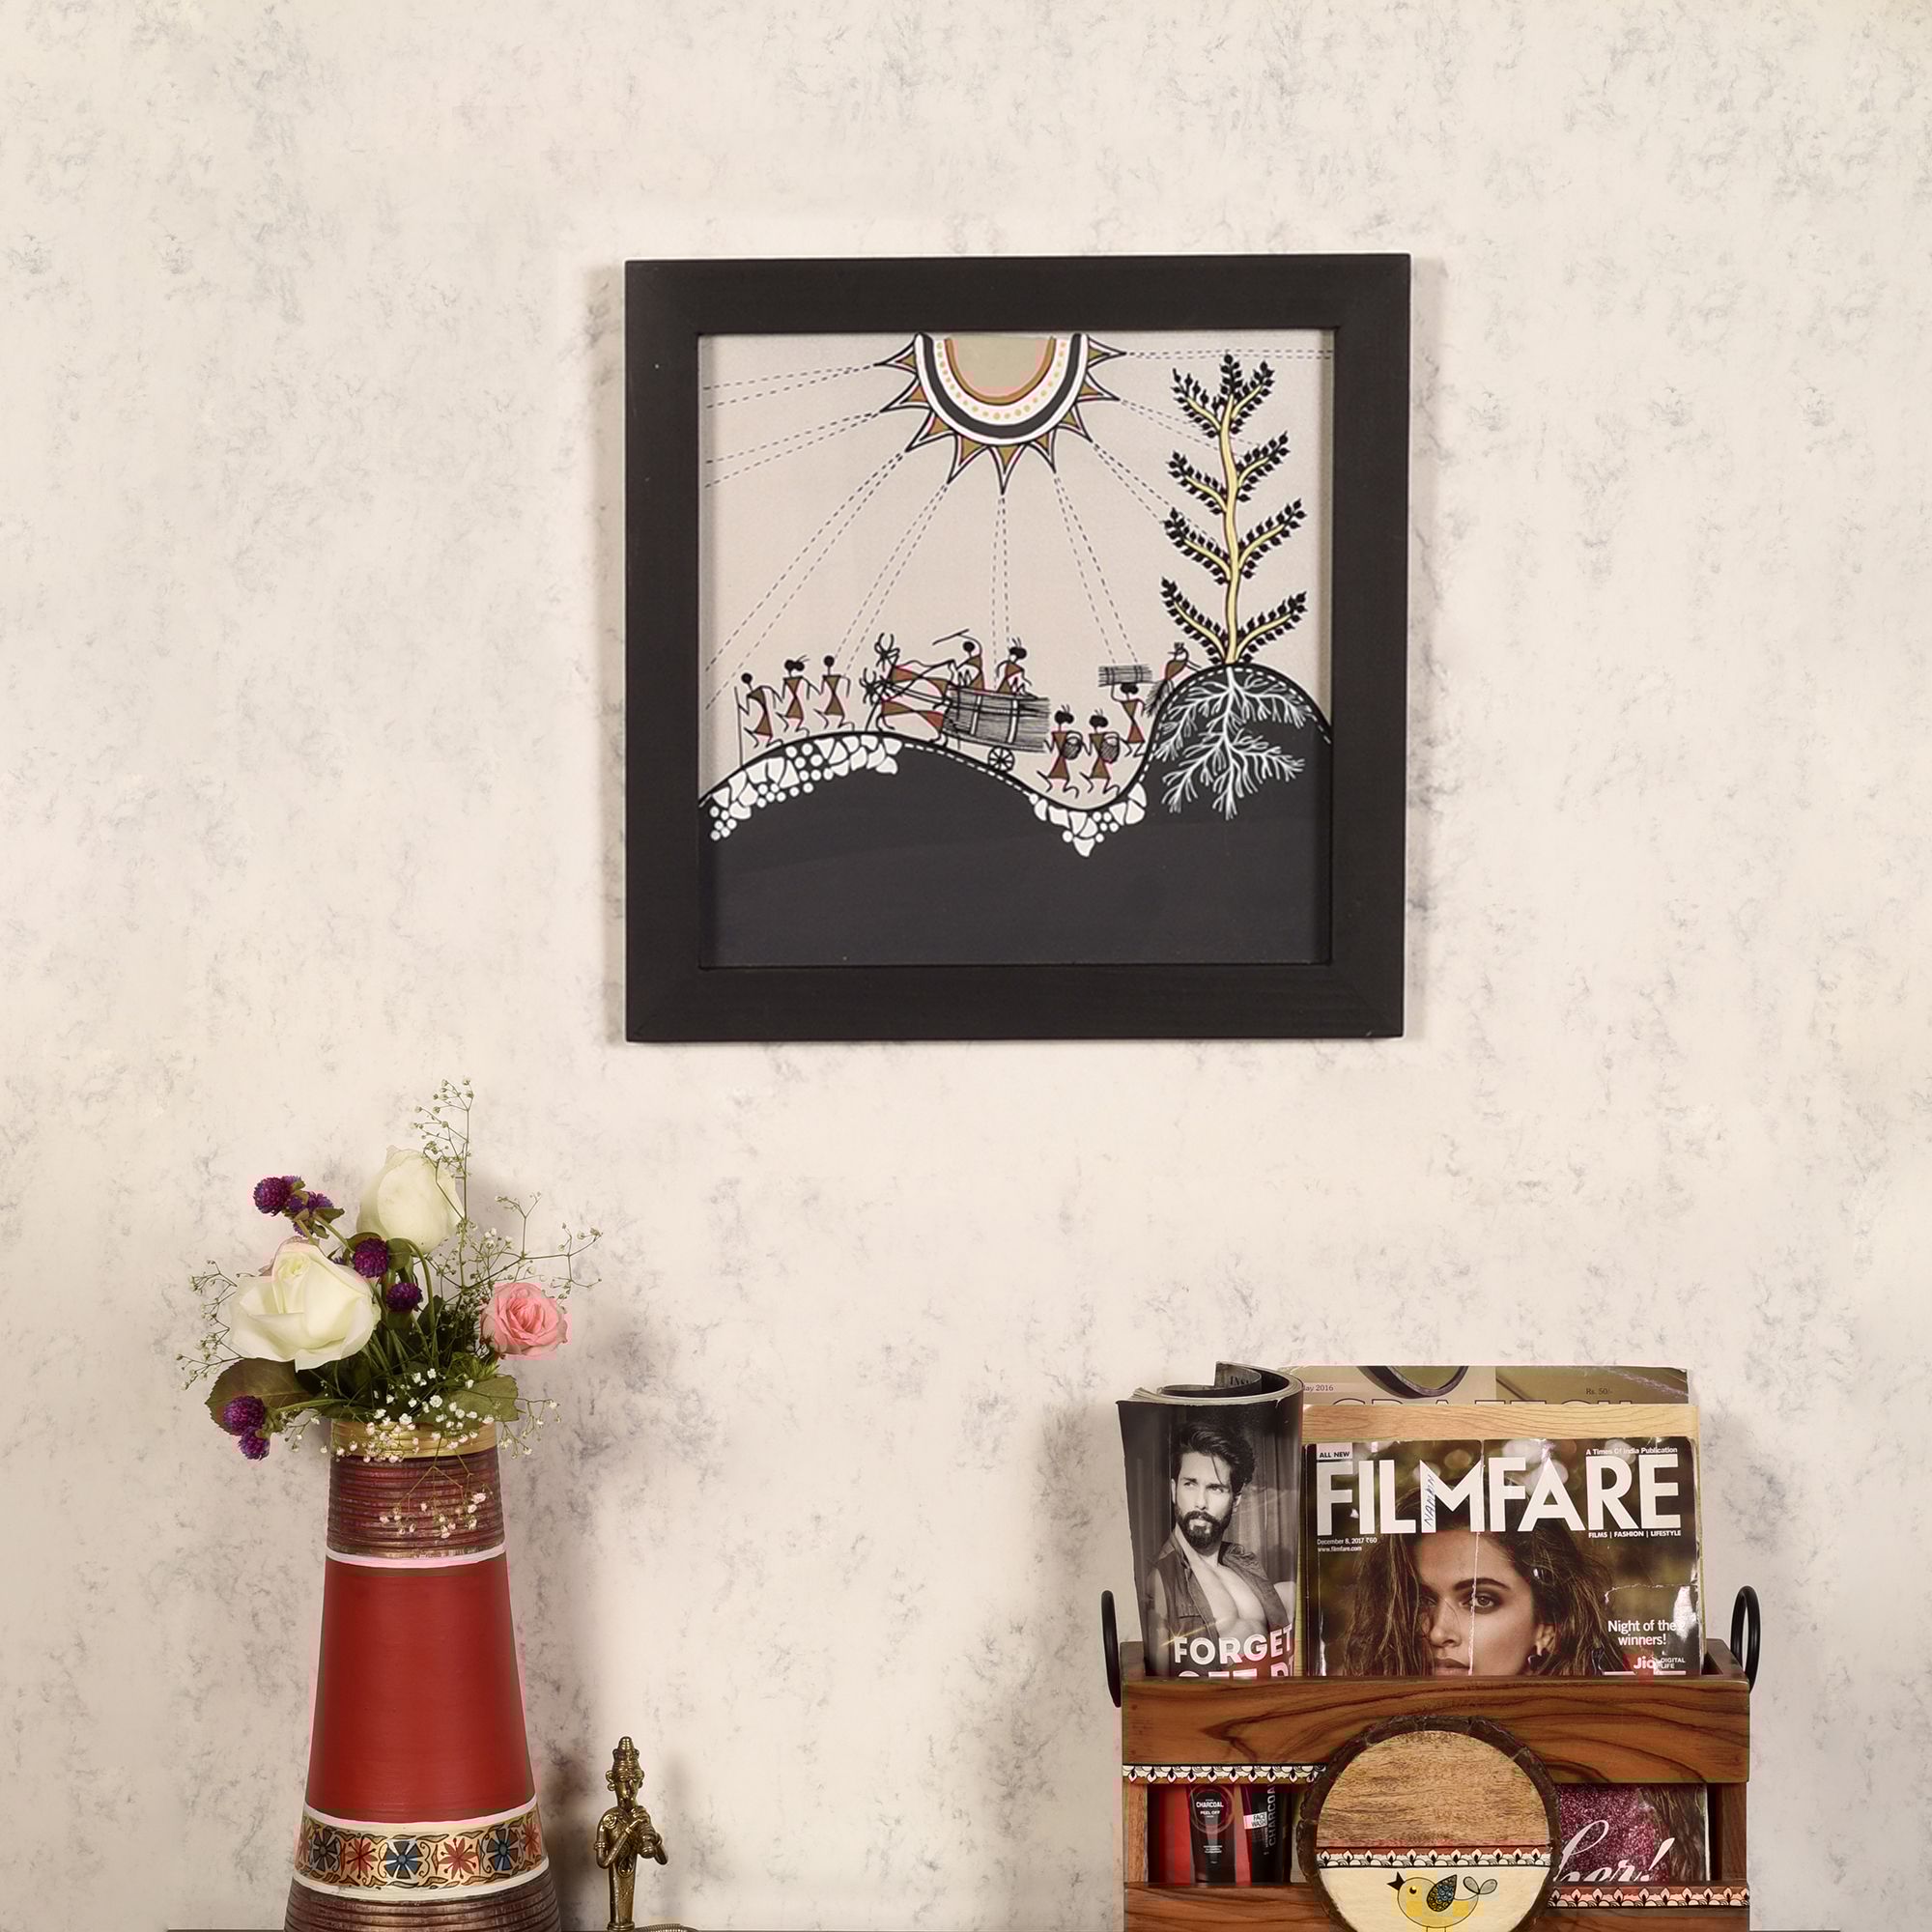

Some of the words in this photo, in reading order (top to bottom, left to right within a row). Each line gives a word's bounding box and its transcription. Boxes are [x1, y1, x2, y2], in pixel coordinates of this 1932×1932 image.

[1317, 1453, 1682, 1536] FILMFARE
[1607, 1620, 1640, 1634] Night
[1642, 1619, 1655, 1632] of
[1658, 1619, 1677, 1632] the
[1174, 1623, 1293, 1665] FORGET
[1617, 1634, 1667, 1646] winners!
[1253, 1812, 1265, 1821] FACE
[1266, 1784, 1276, 1847] CHARCOA
[1251, 1819, 1266, 1828] WASH
